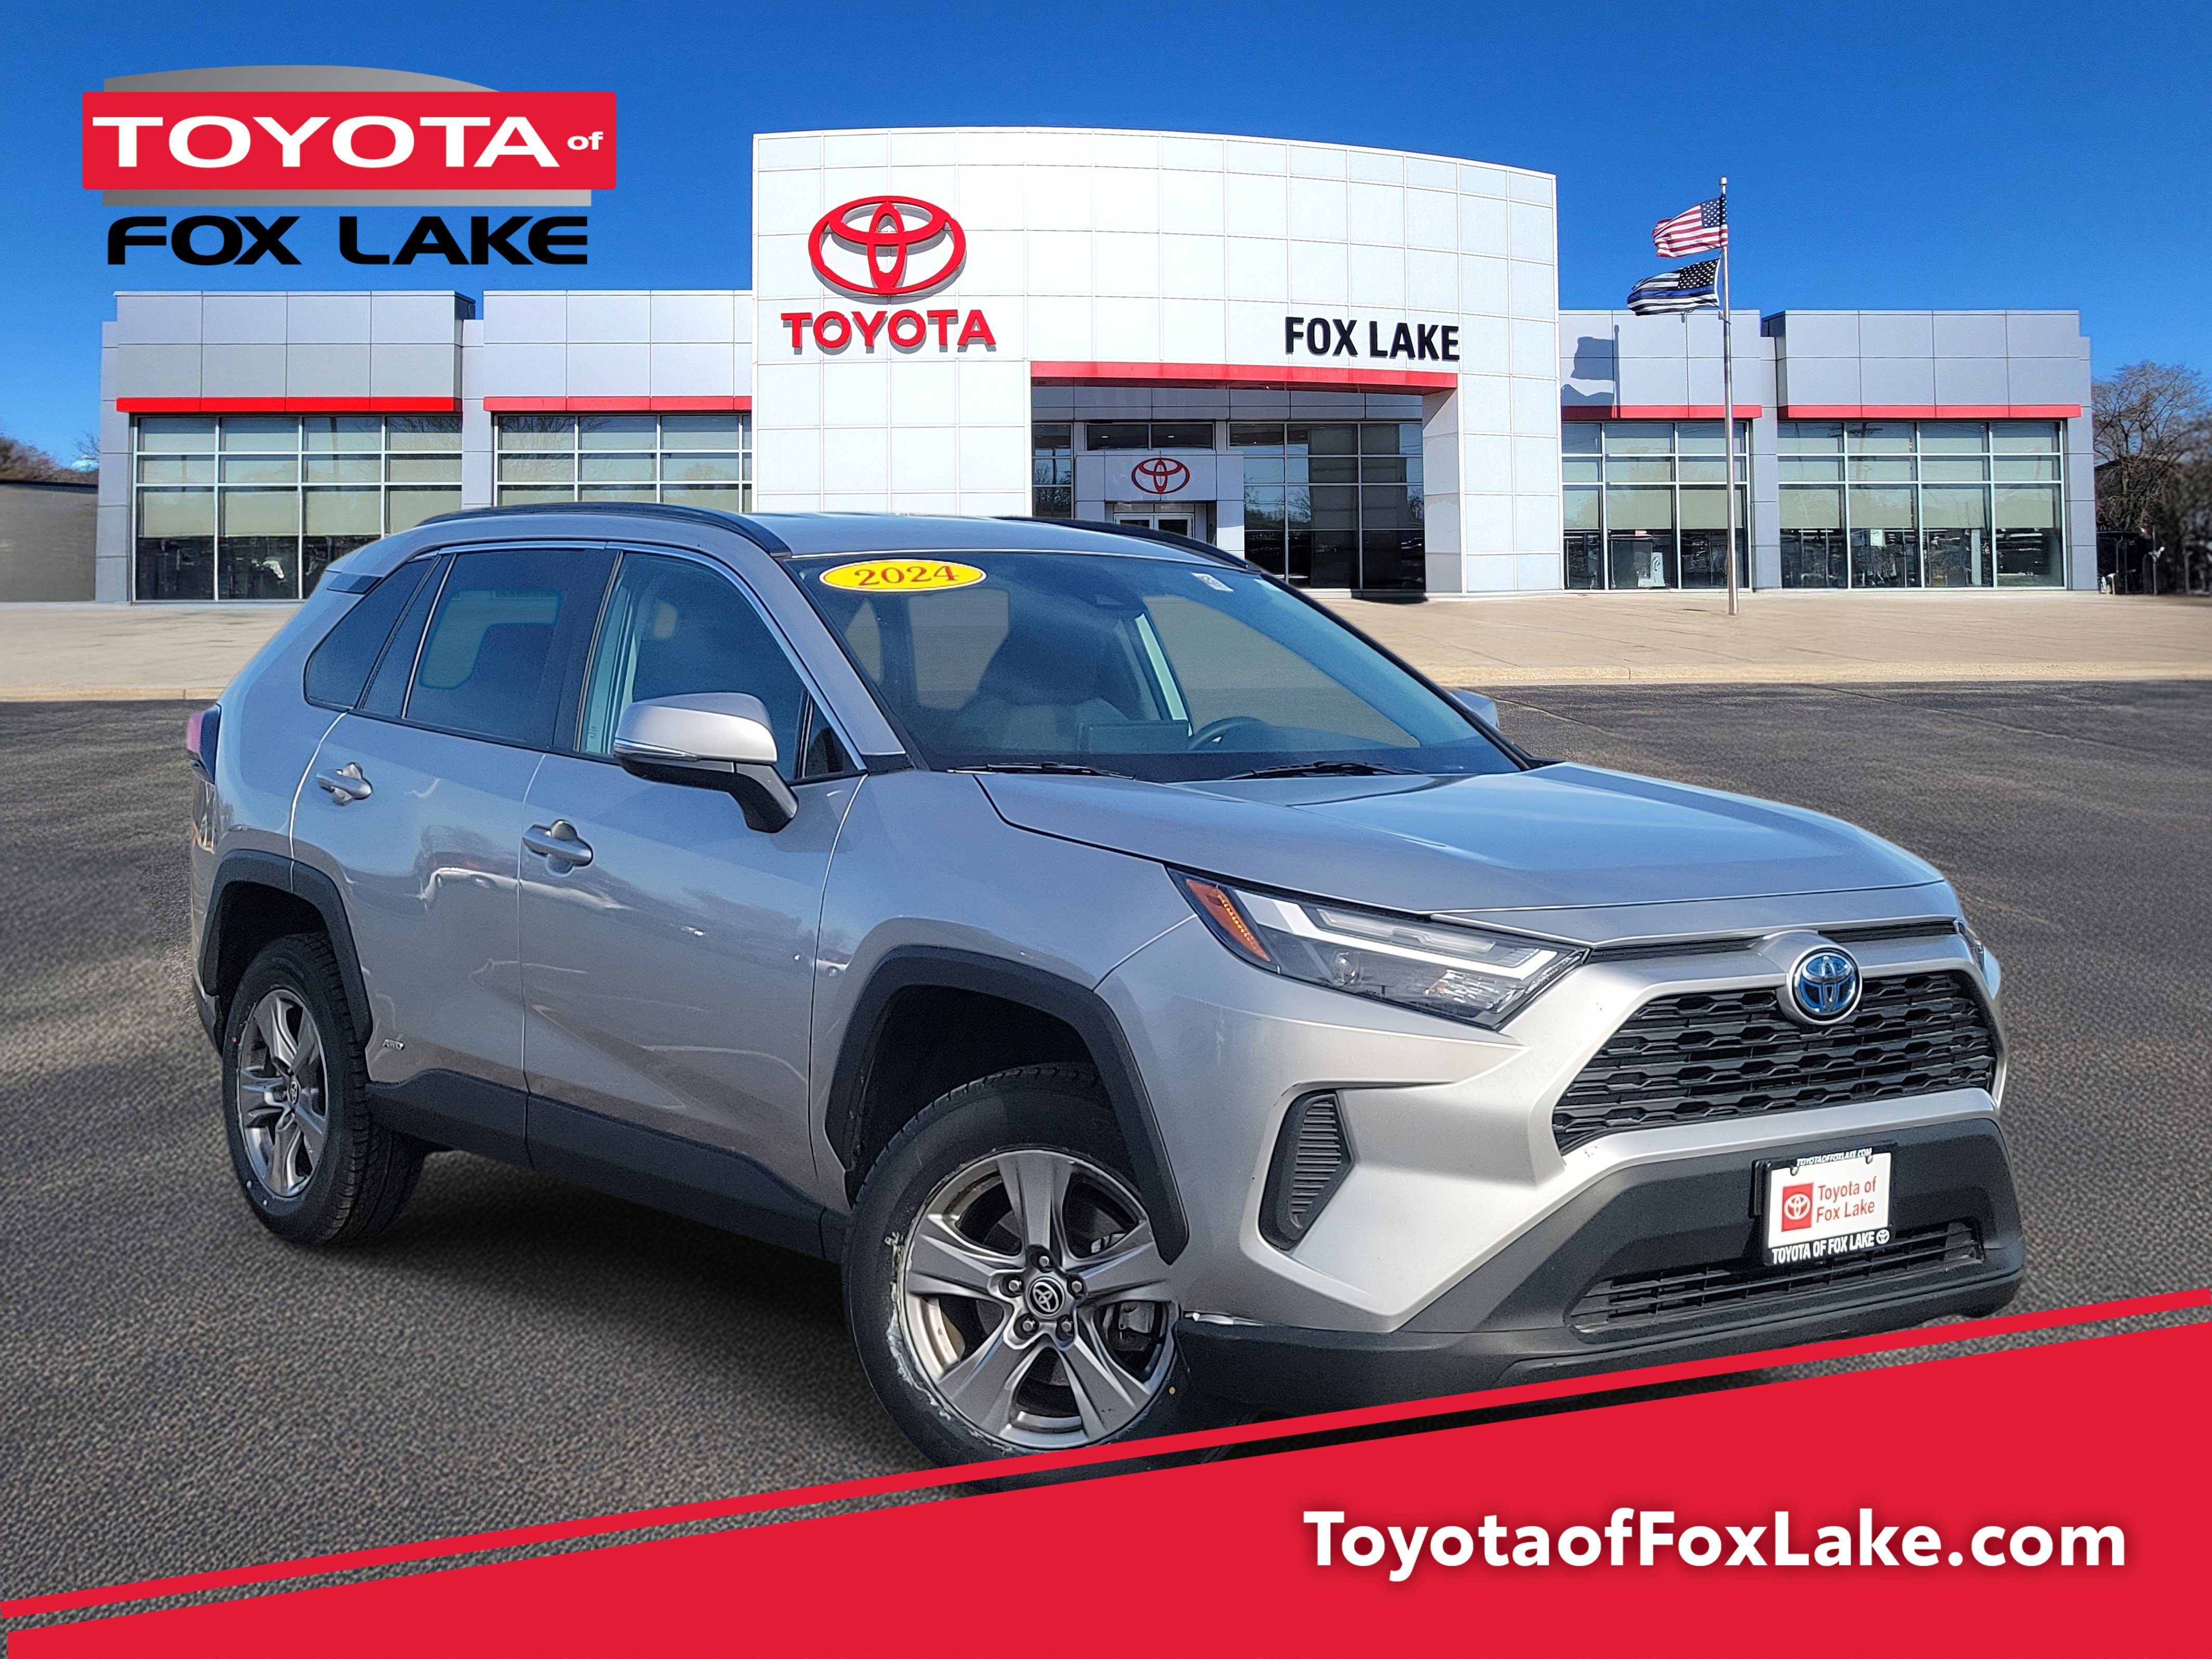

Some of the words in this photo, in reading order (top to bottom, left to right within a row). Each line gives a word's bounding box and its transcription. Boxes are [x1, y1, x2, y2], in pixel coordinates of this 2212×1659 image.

[781, 310, 997, 353] TOYOTA
[1285, 317, 1358, 357] FOX
[1370, 321, 1460, 361] LAKE
[854, 566, 959, 586] 2024
[1818, 1181, 1860, 1203] Toyota
[1864, 1176, 1877, 1193] of
[1816, 1206, 1840, 1223] Fox
[1844, 1199, 1875, 1218] Lake
[1772, 1243, 1811, 1264] TOYOTA
[1813, 1239, 1827, 1257] OF
[1827, 1235, 1848, 1255] FOX
[1849, 1231, 1875, 1250] LAKE
